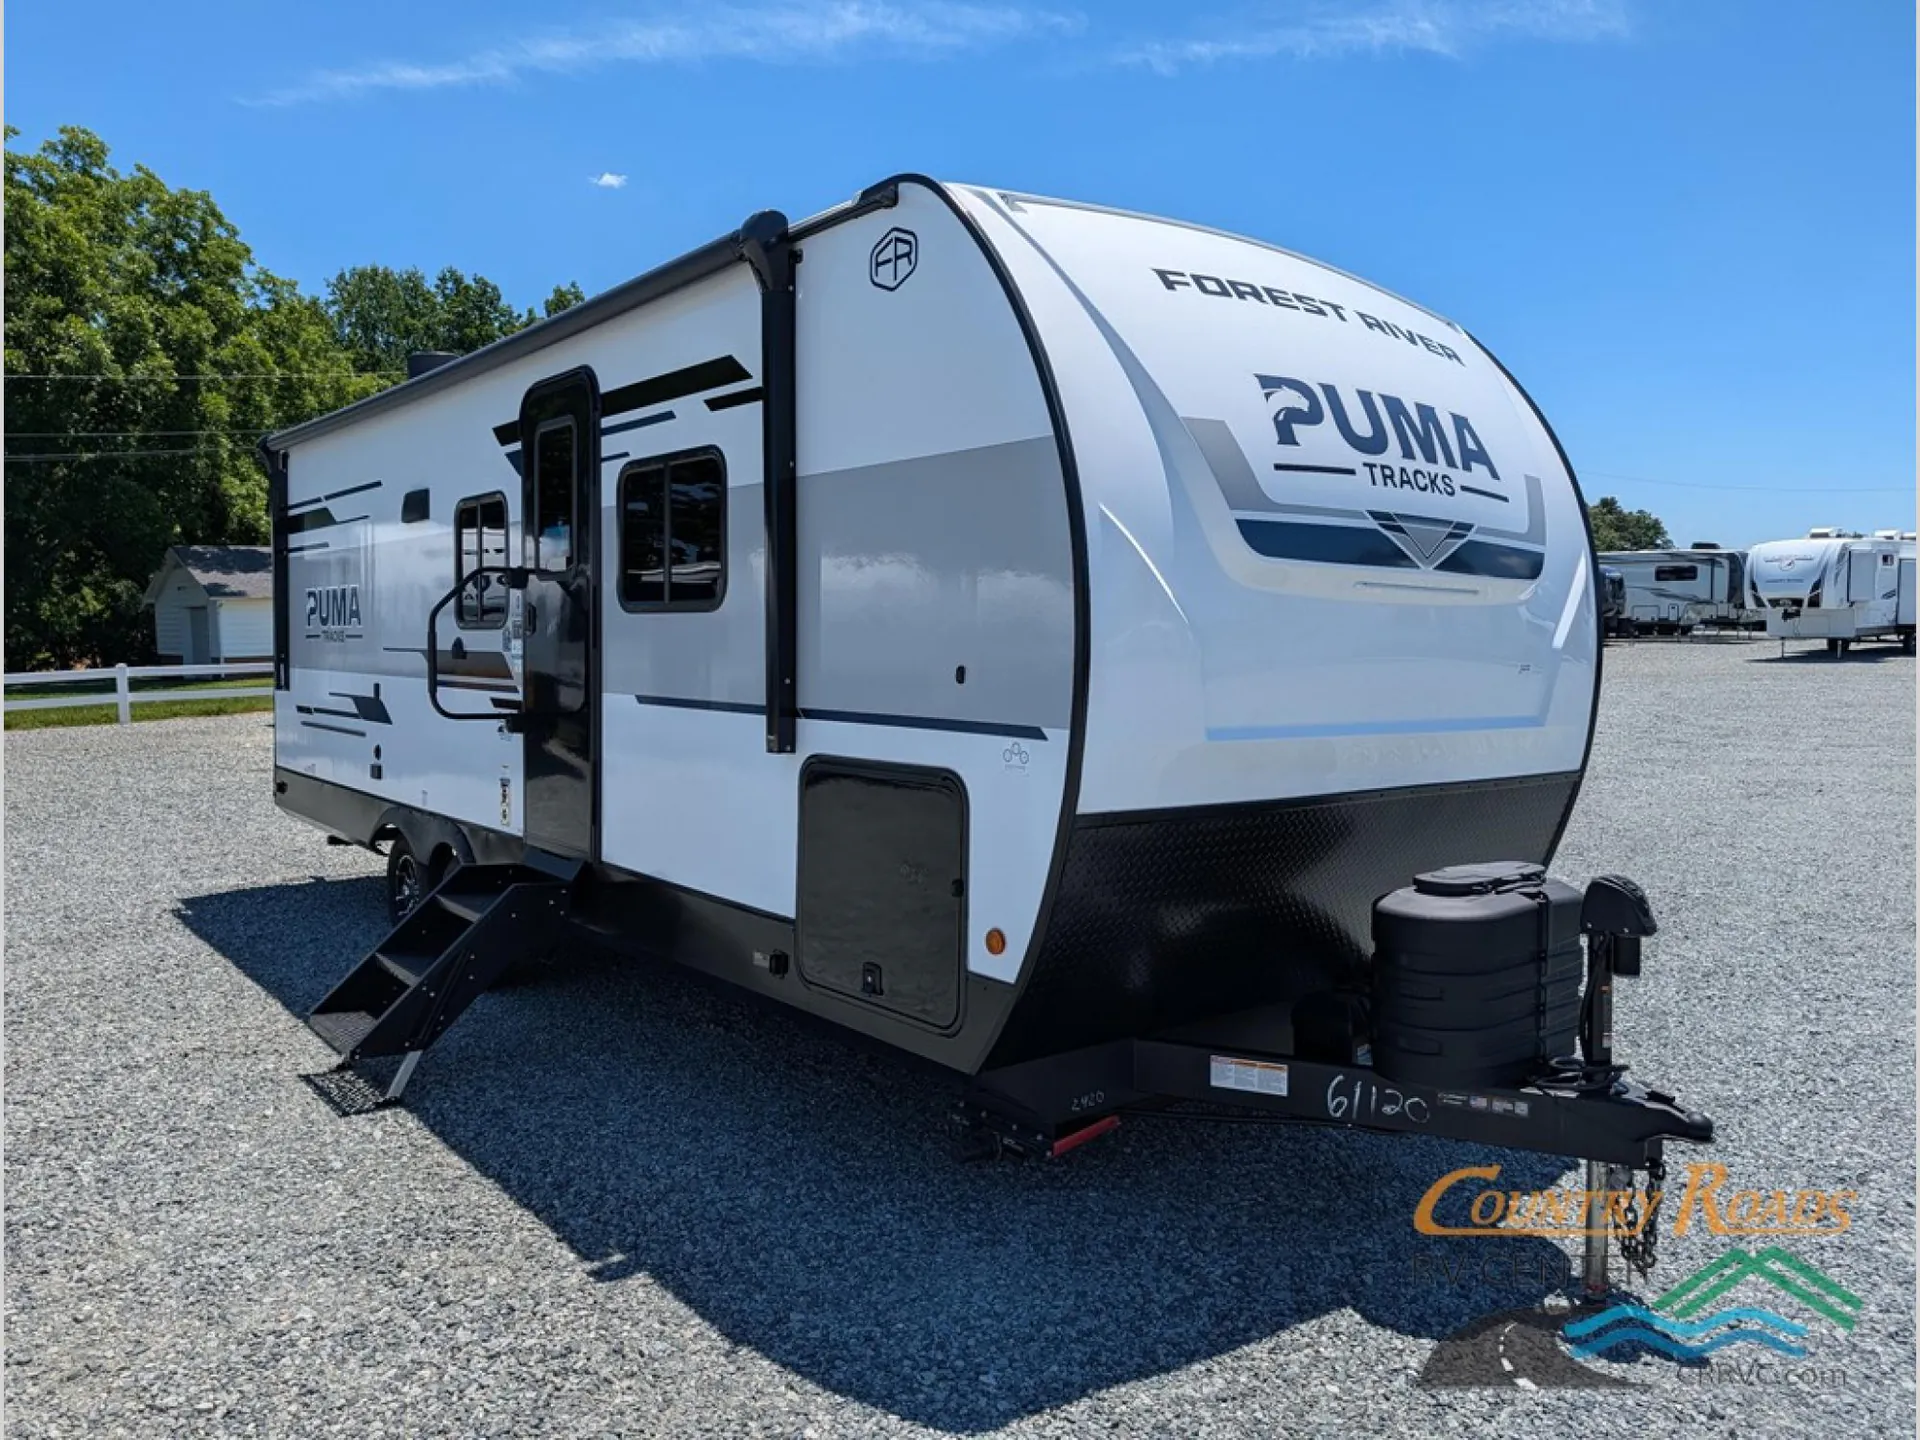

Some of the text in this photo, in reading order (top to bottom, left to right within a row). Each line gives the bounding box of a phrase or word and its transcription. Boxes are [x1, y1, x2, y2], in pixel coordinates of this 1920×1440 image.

[1151, 267, 1466, 367] FOREST RIVER
[1253, 373, 1501, 481] PUMA
[1362, 462, 1456, 496] TRACKS
[306, 586, 361, 627] PUMA
